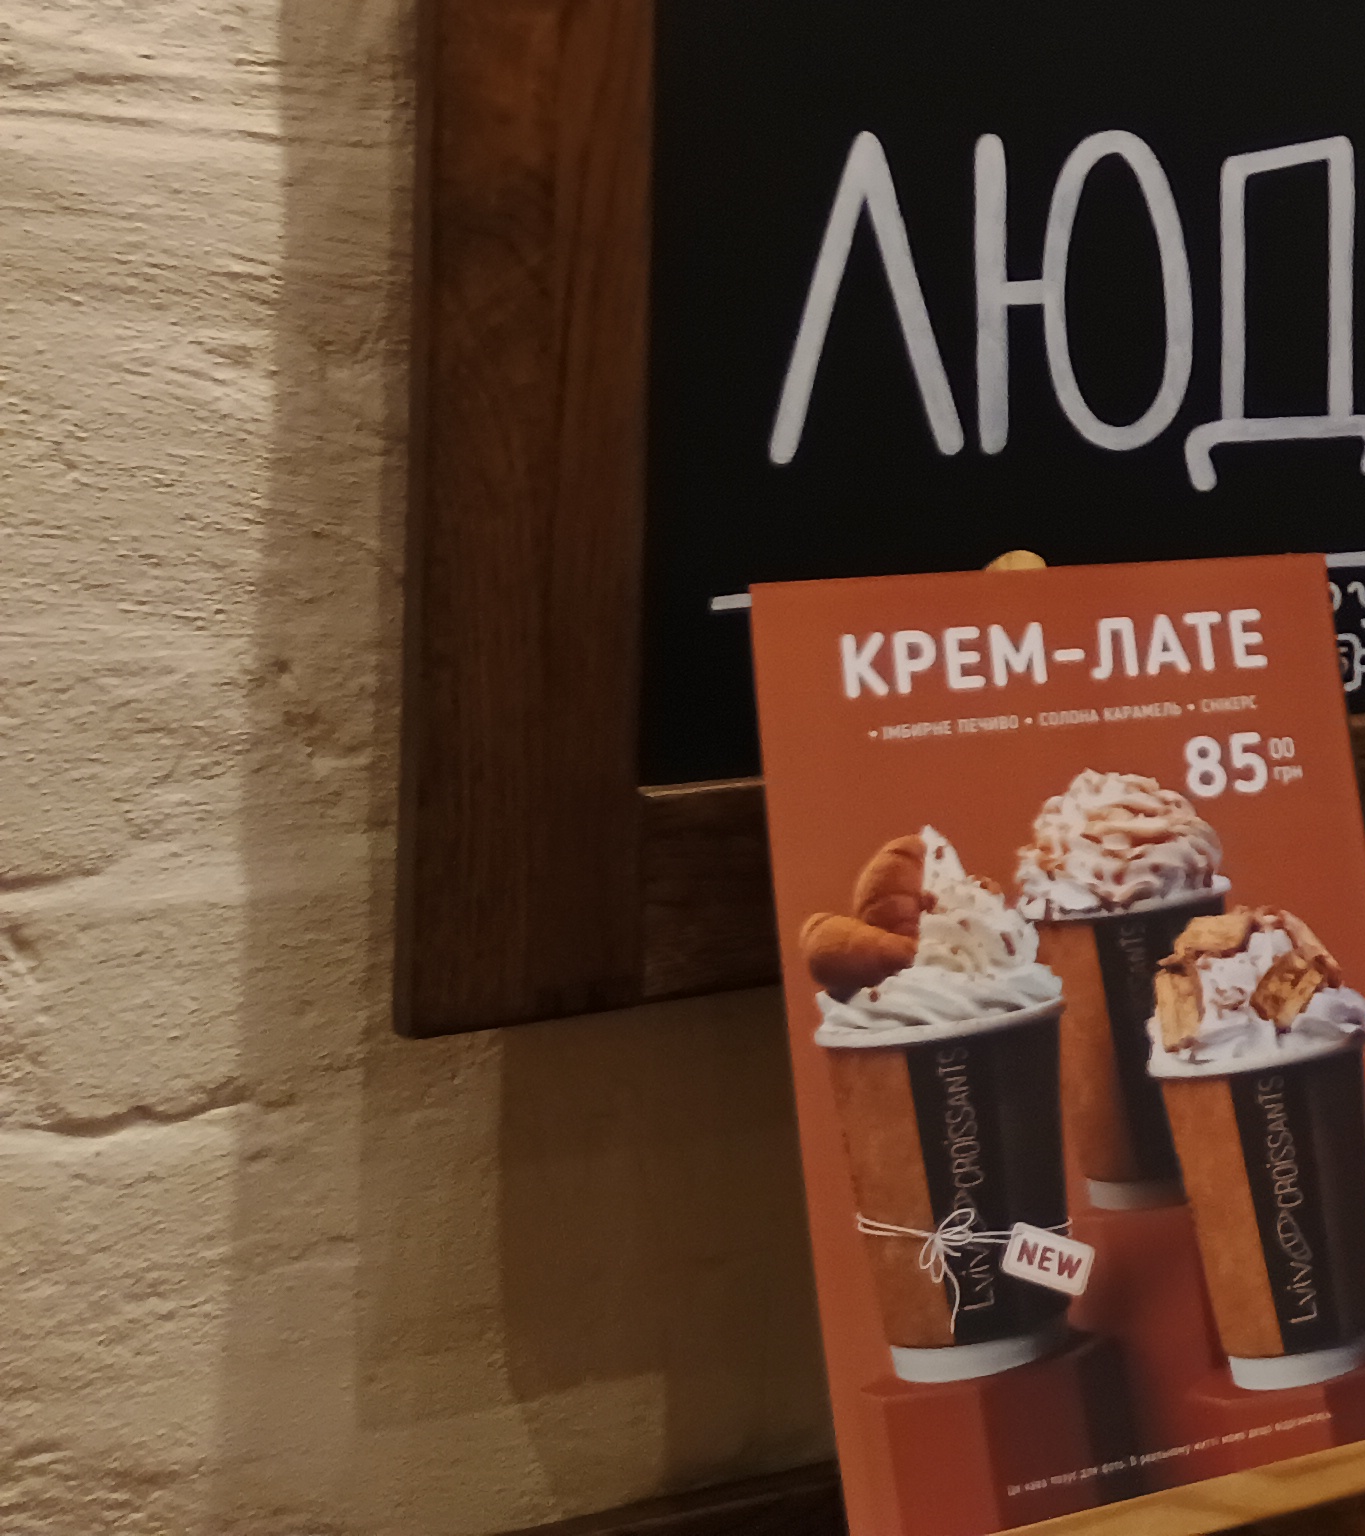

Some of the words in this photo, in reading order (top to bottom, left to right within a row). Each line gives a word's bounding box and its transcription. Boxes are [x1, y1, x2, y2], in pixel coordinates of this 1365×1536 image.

[840, 609, 1268, 700] КРЕМ-ЛАТЕ
[1186, 732, 1269, 797] 85
[1270, 736, 1295, 759] 00
[1273, 762, 1303, 784] грн
[1016, 1239, 1083, 1280] NEW
